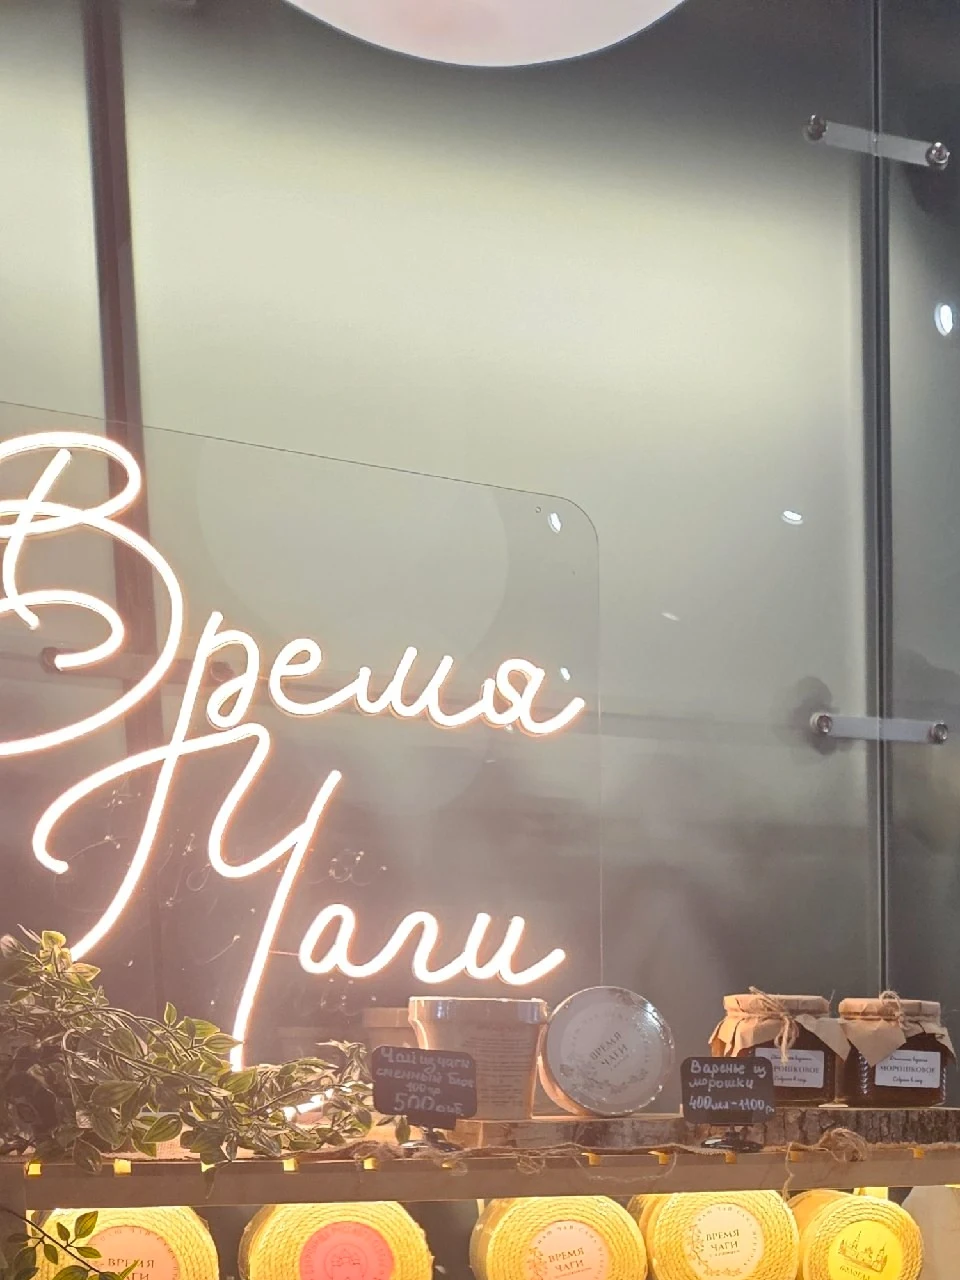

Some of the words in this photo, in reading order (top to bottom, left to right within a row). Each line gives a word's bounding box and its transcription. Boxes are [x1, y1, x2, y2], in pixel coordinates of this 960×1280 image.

[0, 430, 587, 963] Время
[33, 722, 567, 1073] Чаги
[773, 1065, 820, 1074] РОШКОВОЕ
[689, 1077, 754, 1093] морошки
[706, 1229, 740, 1241] ВРЕМЯ
[711, 1240, 738, 1252] ЧАГИ
[548, 1247, 584, 1263] ВРЕМЯ
[555, 1260, 584, 1272] ЧАГИ
